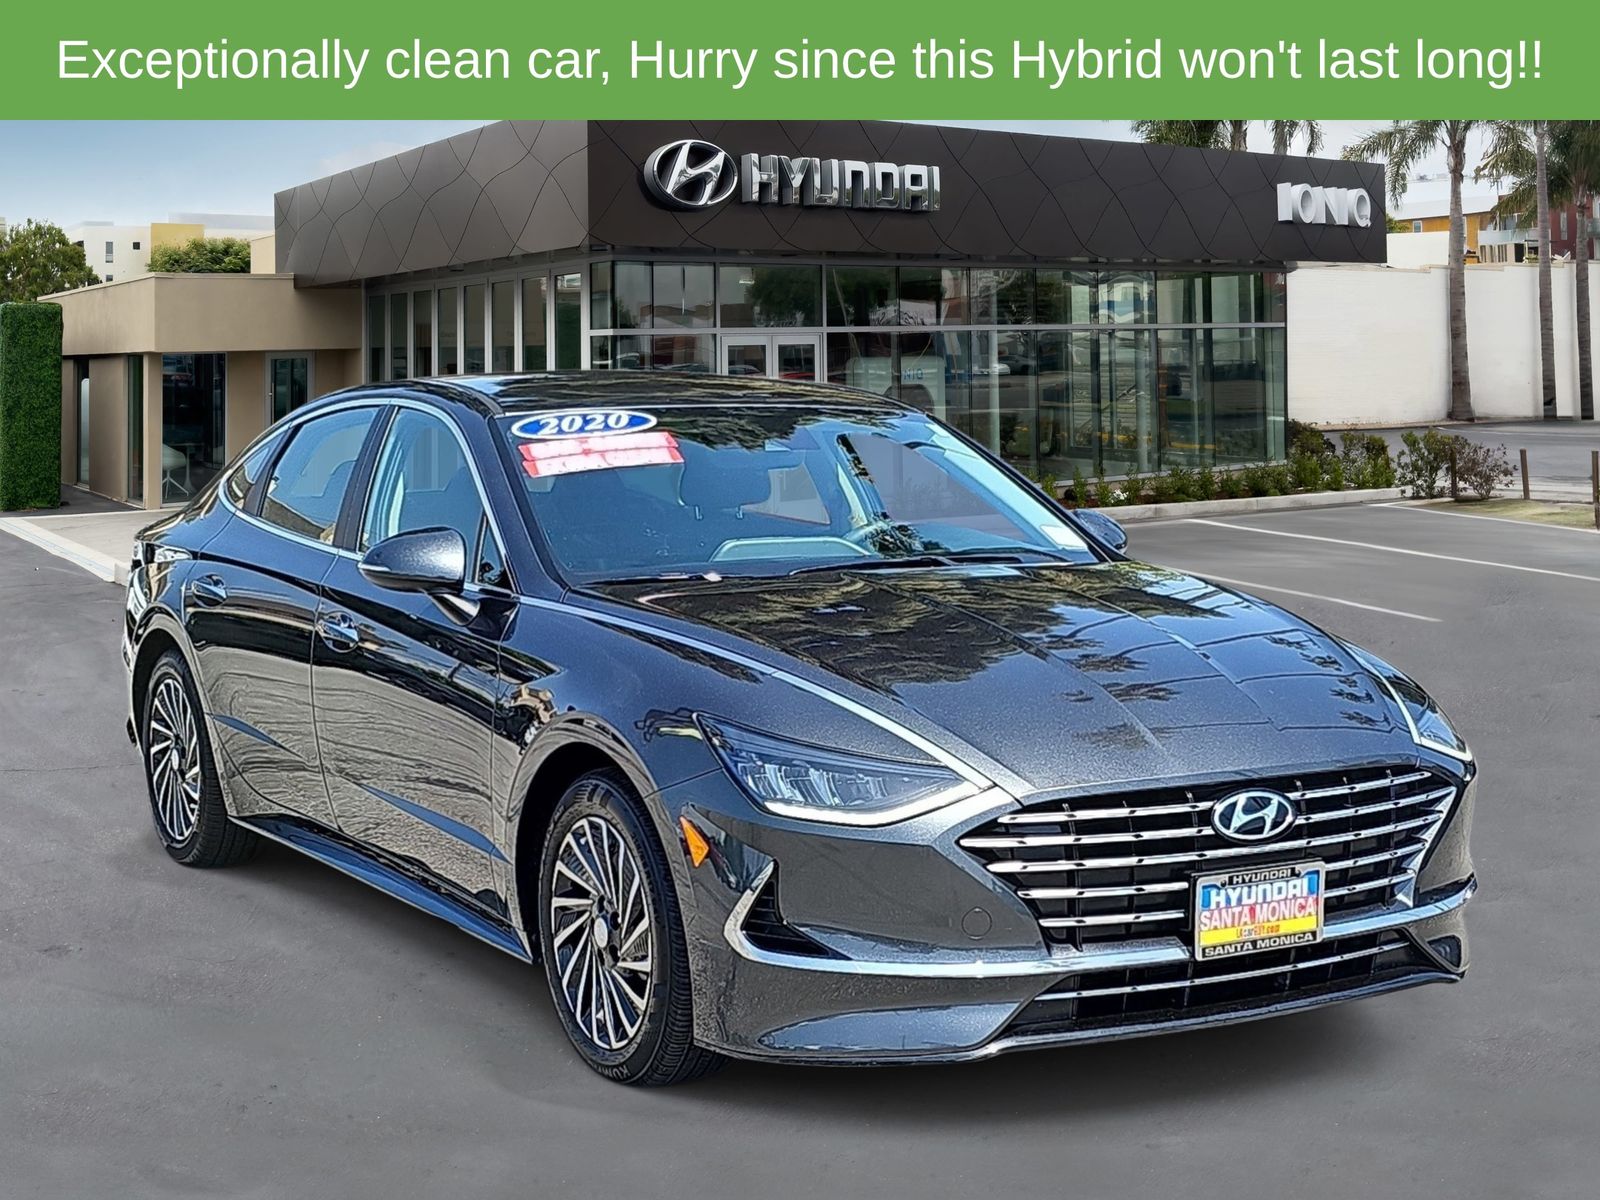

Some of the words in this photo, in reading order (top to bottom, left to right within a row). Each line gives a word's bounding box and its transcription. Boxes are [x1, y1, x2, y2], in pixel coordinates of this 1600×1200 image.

[741, 153, 940, 210] HYUNDAI
[1277, 182, 1371, 228] IONIQ
[537, 413, 629, 436] 2020
[1233, 868, 1291, 885] HYUNDAI
[1210, 878, 1308, 909] HYUNDAI
[1200, 903, 1253, 932] SANTA
[1255, 896, 1317, 924] MONICA
[1205, 943, 1253, 956] SANTA
[1256, 932, 1313, 948] MONICA
